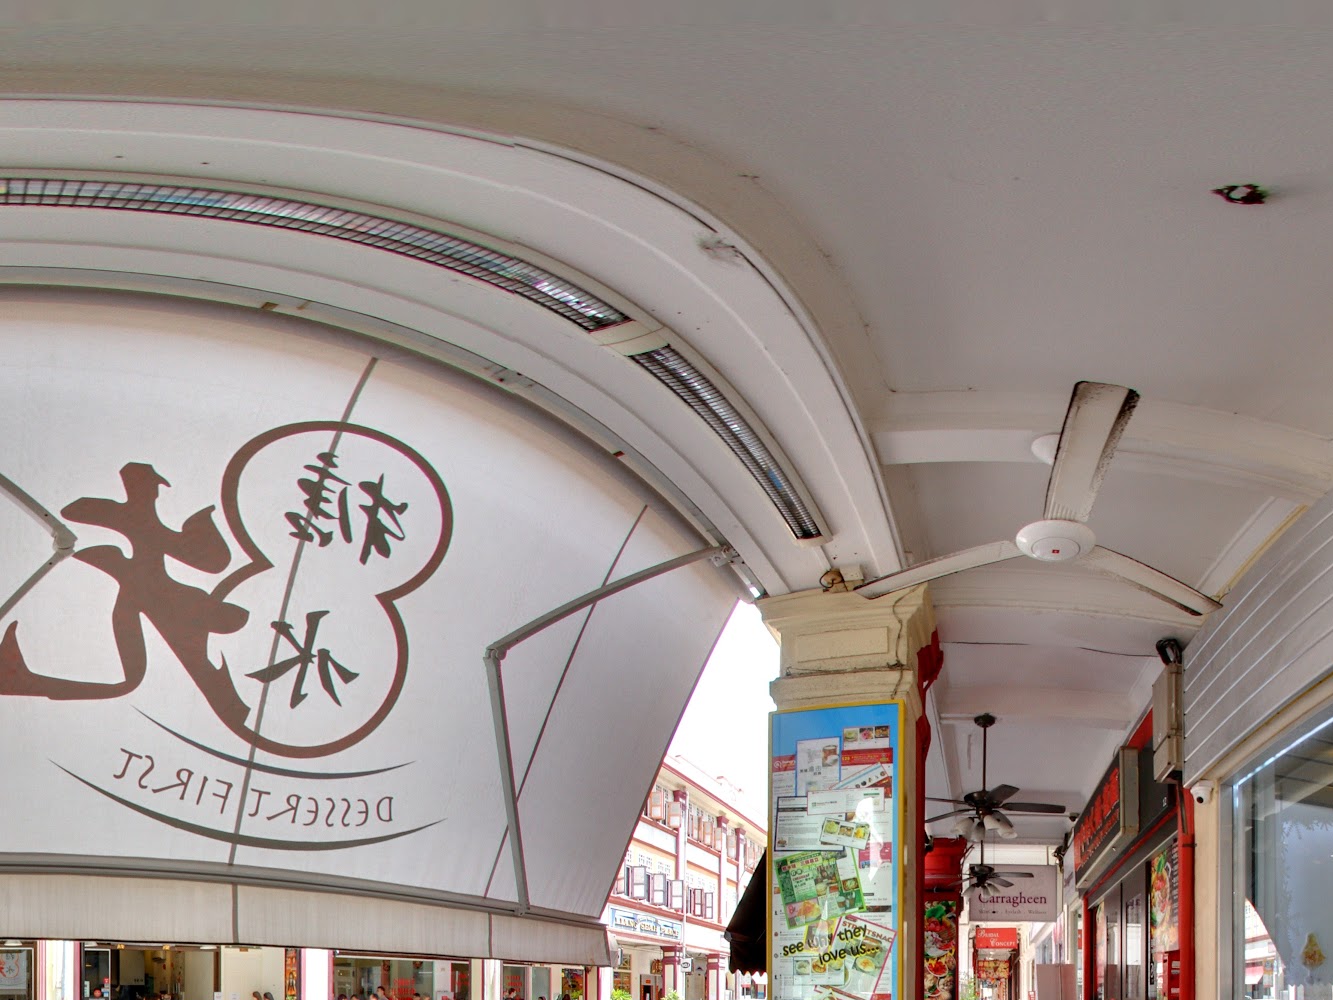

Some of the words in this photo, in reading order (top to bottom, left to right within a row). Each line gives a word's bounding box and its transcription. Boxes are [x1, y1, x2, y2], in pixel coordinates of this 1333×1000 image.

[978, 892, 1047, 908] Carragheen
[782, 941, 804, 957] see
[837, 924, 868, 941] they
[819, 947, 847, 965] love
